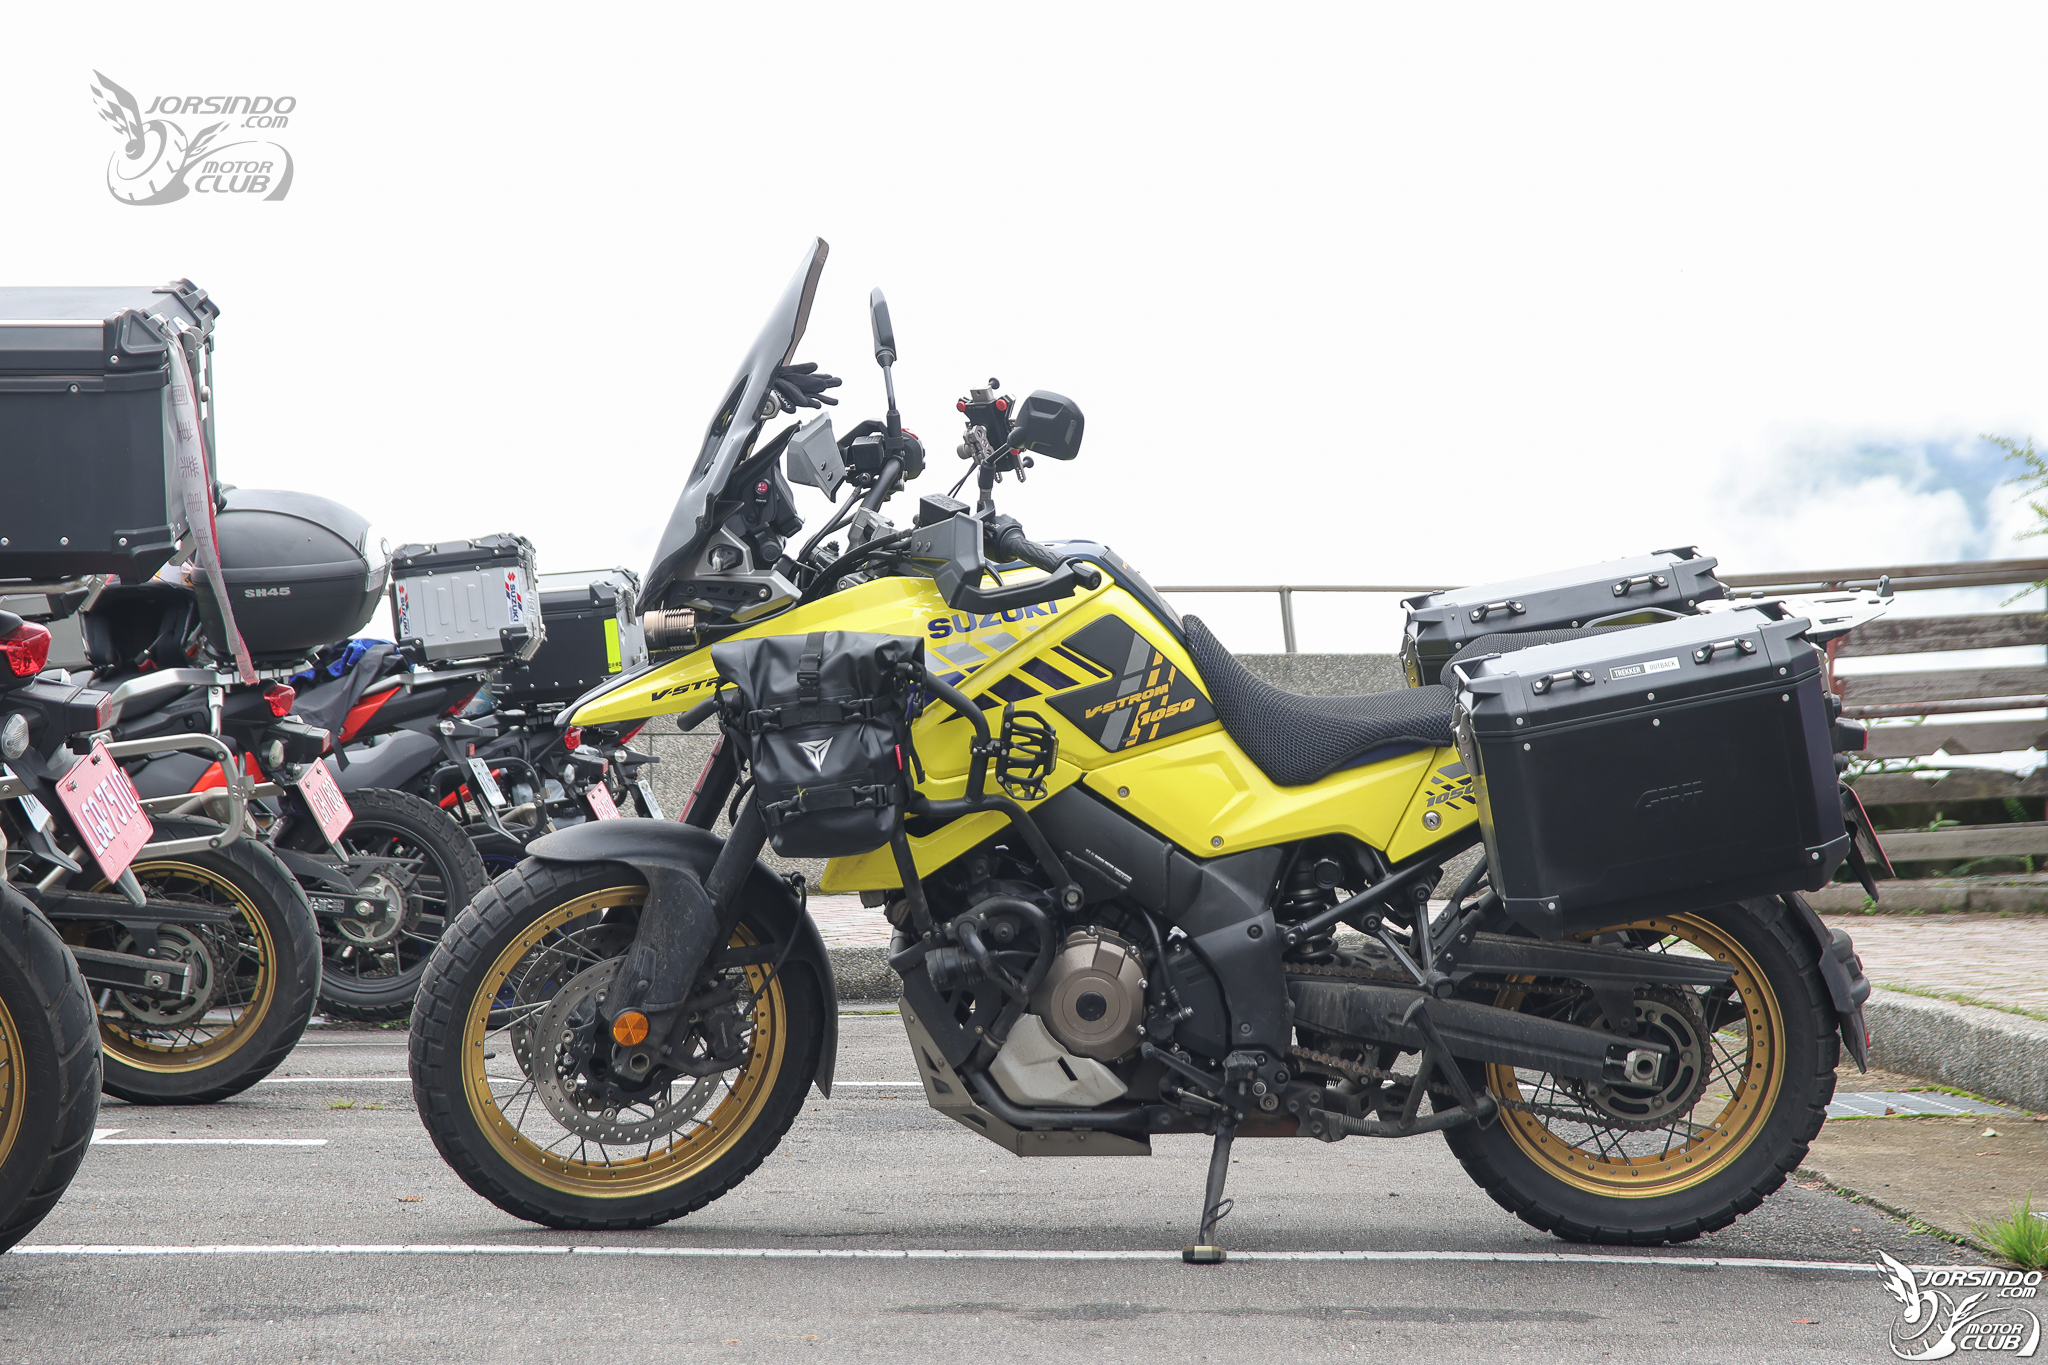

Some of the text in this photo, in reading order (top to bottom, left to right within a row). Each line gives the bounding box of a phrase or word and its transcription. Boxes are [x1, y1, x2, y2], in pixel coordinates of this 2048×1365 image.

[244, 586, 291, 598] SH45
[510, 583, 519, 622] SUZUKI
[400, 597, 410, 635] SUZUKI
[928, 600, 1058, 639] SUZUKI
[1613, 660, 1676, 679] TREKKER OUTBACK
[1085, 683, 1169, 719] V-STROM
[1140, 698, 1196, 726] 1050
[1426, 784, 1475, 808] 1050
